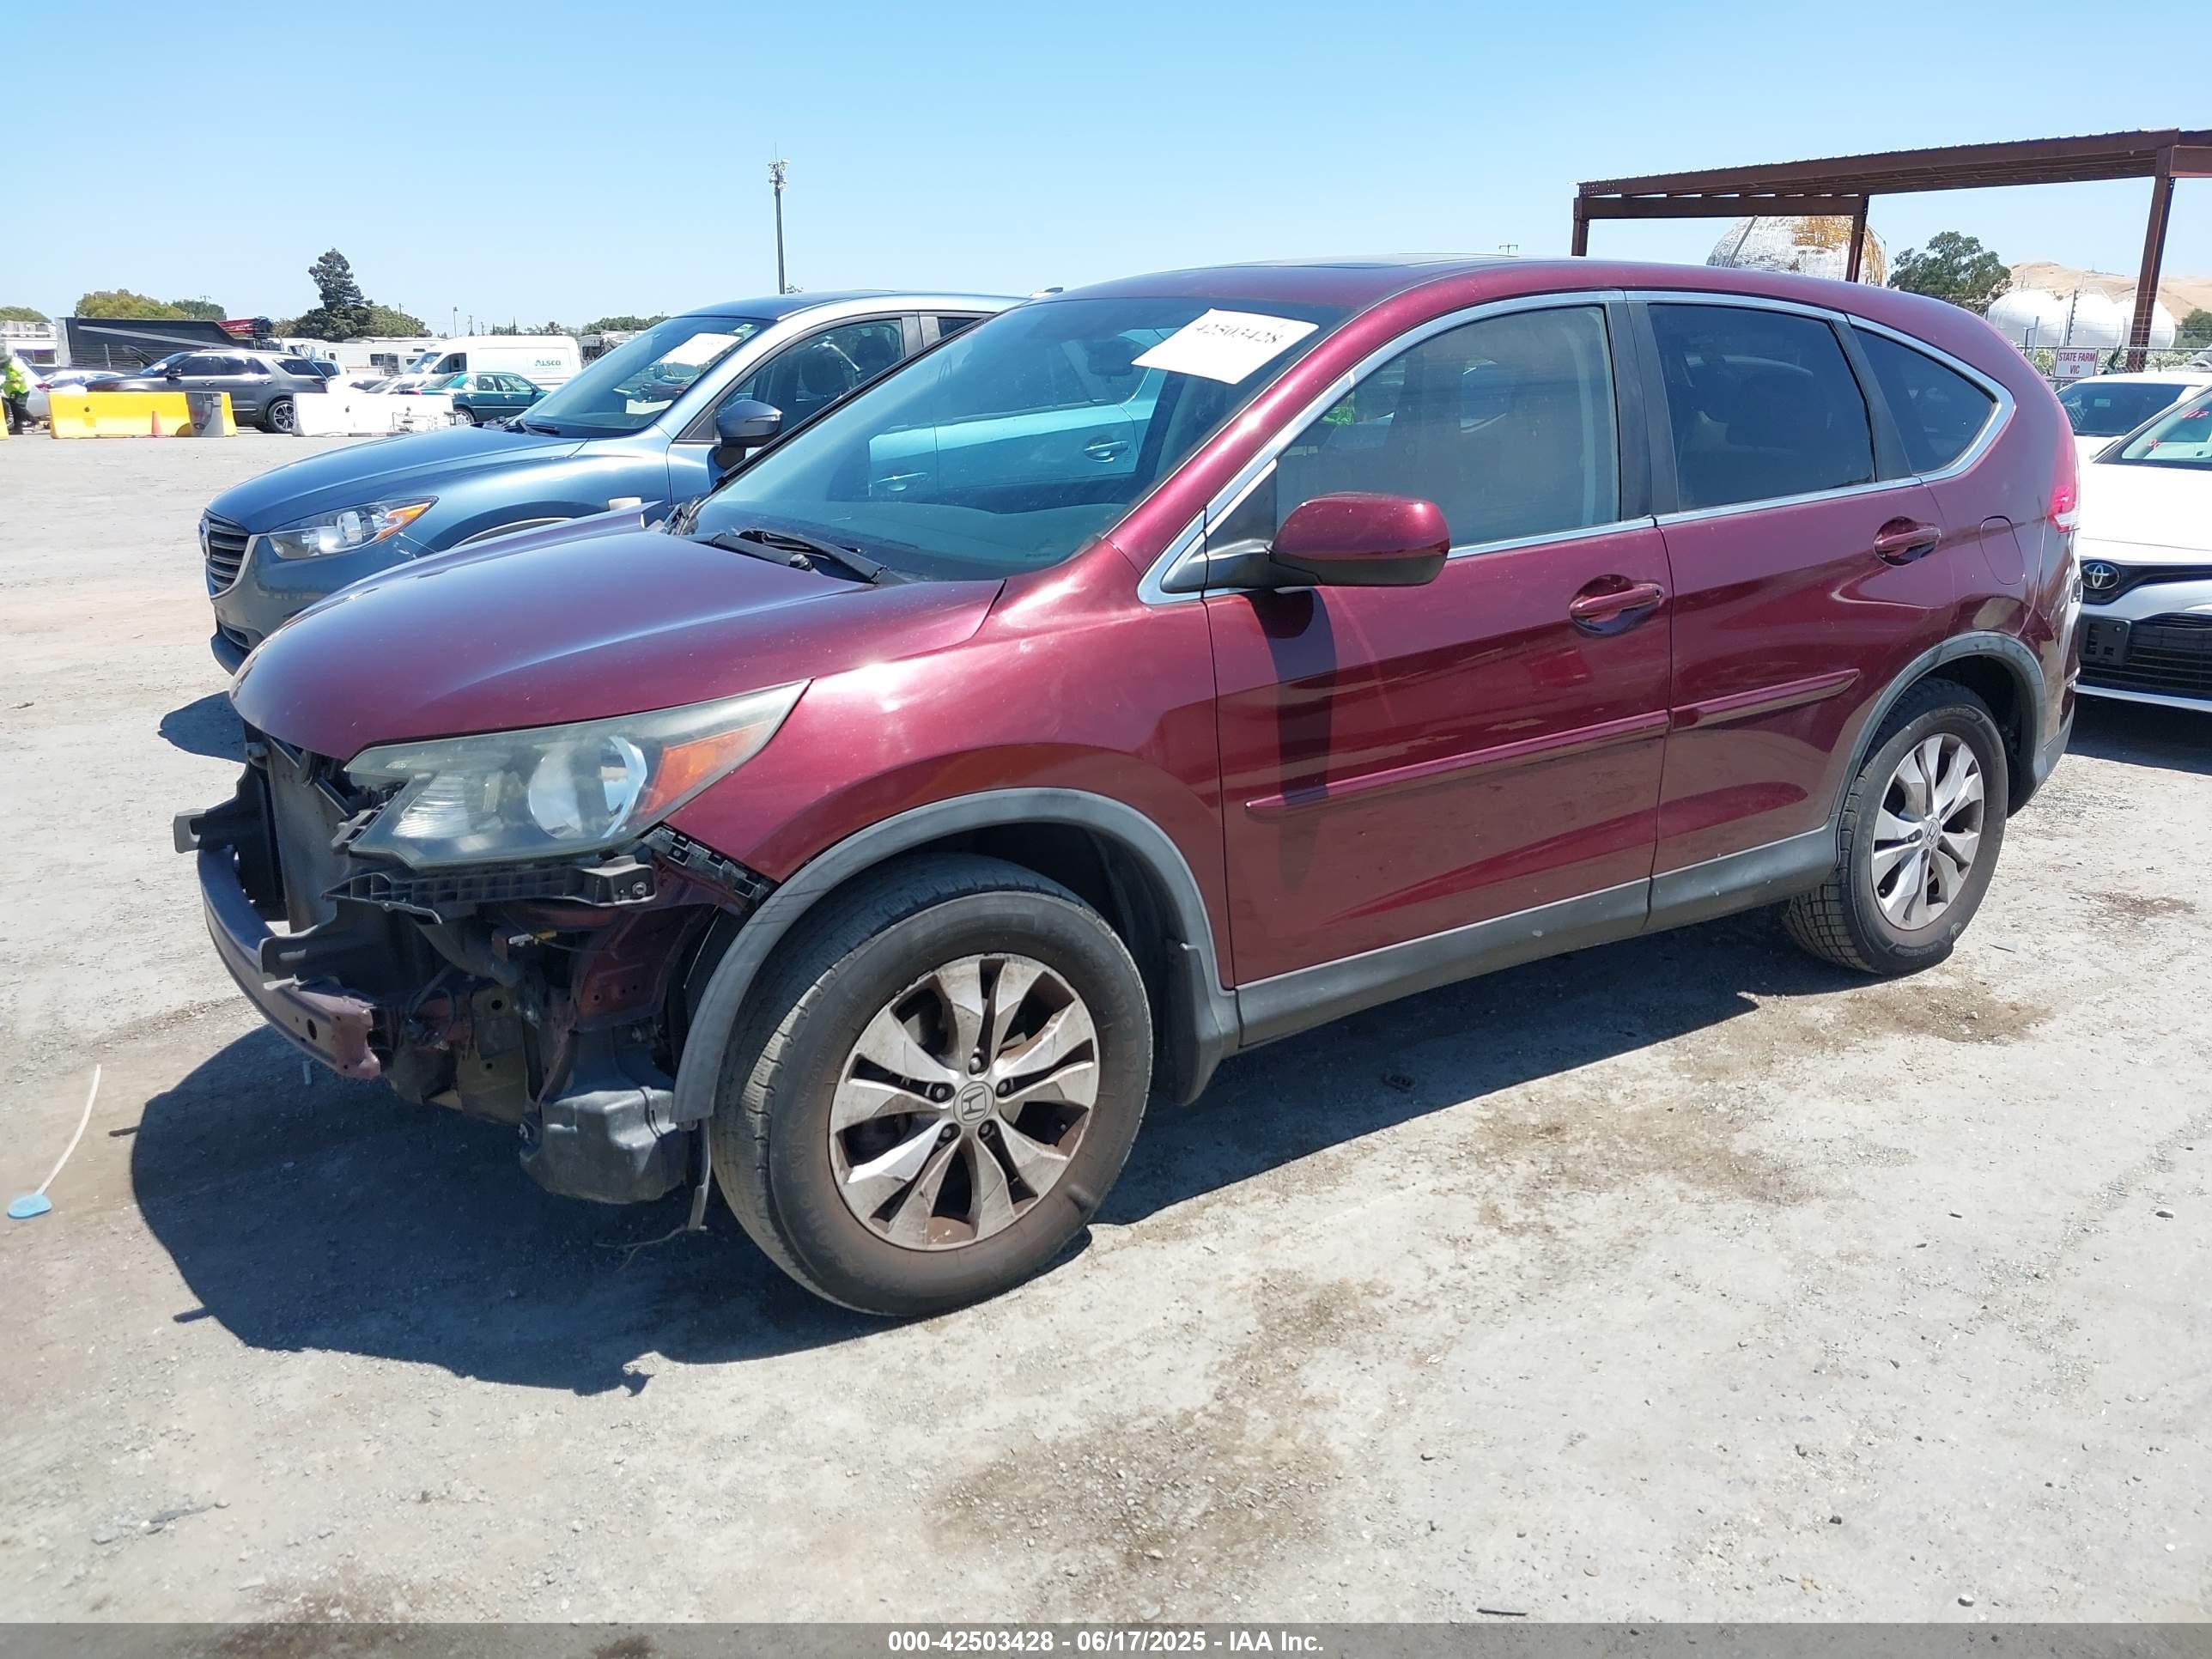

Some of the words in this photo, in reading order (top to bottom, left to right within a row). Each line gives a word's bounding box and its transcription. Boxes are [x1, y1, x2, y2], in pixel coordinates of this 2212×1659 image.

[2058, 352, 2077, 362] STATE
[2078, 352, 2096, 362] FARM
[2069, 365, 2081, 374] VIC
